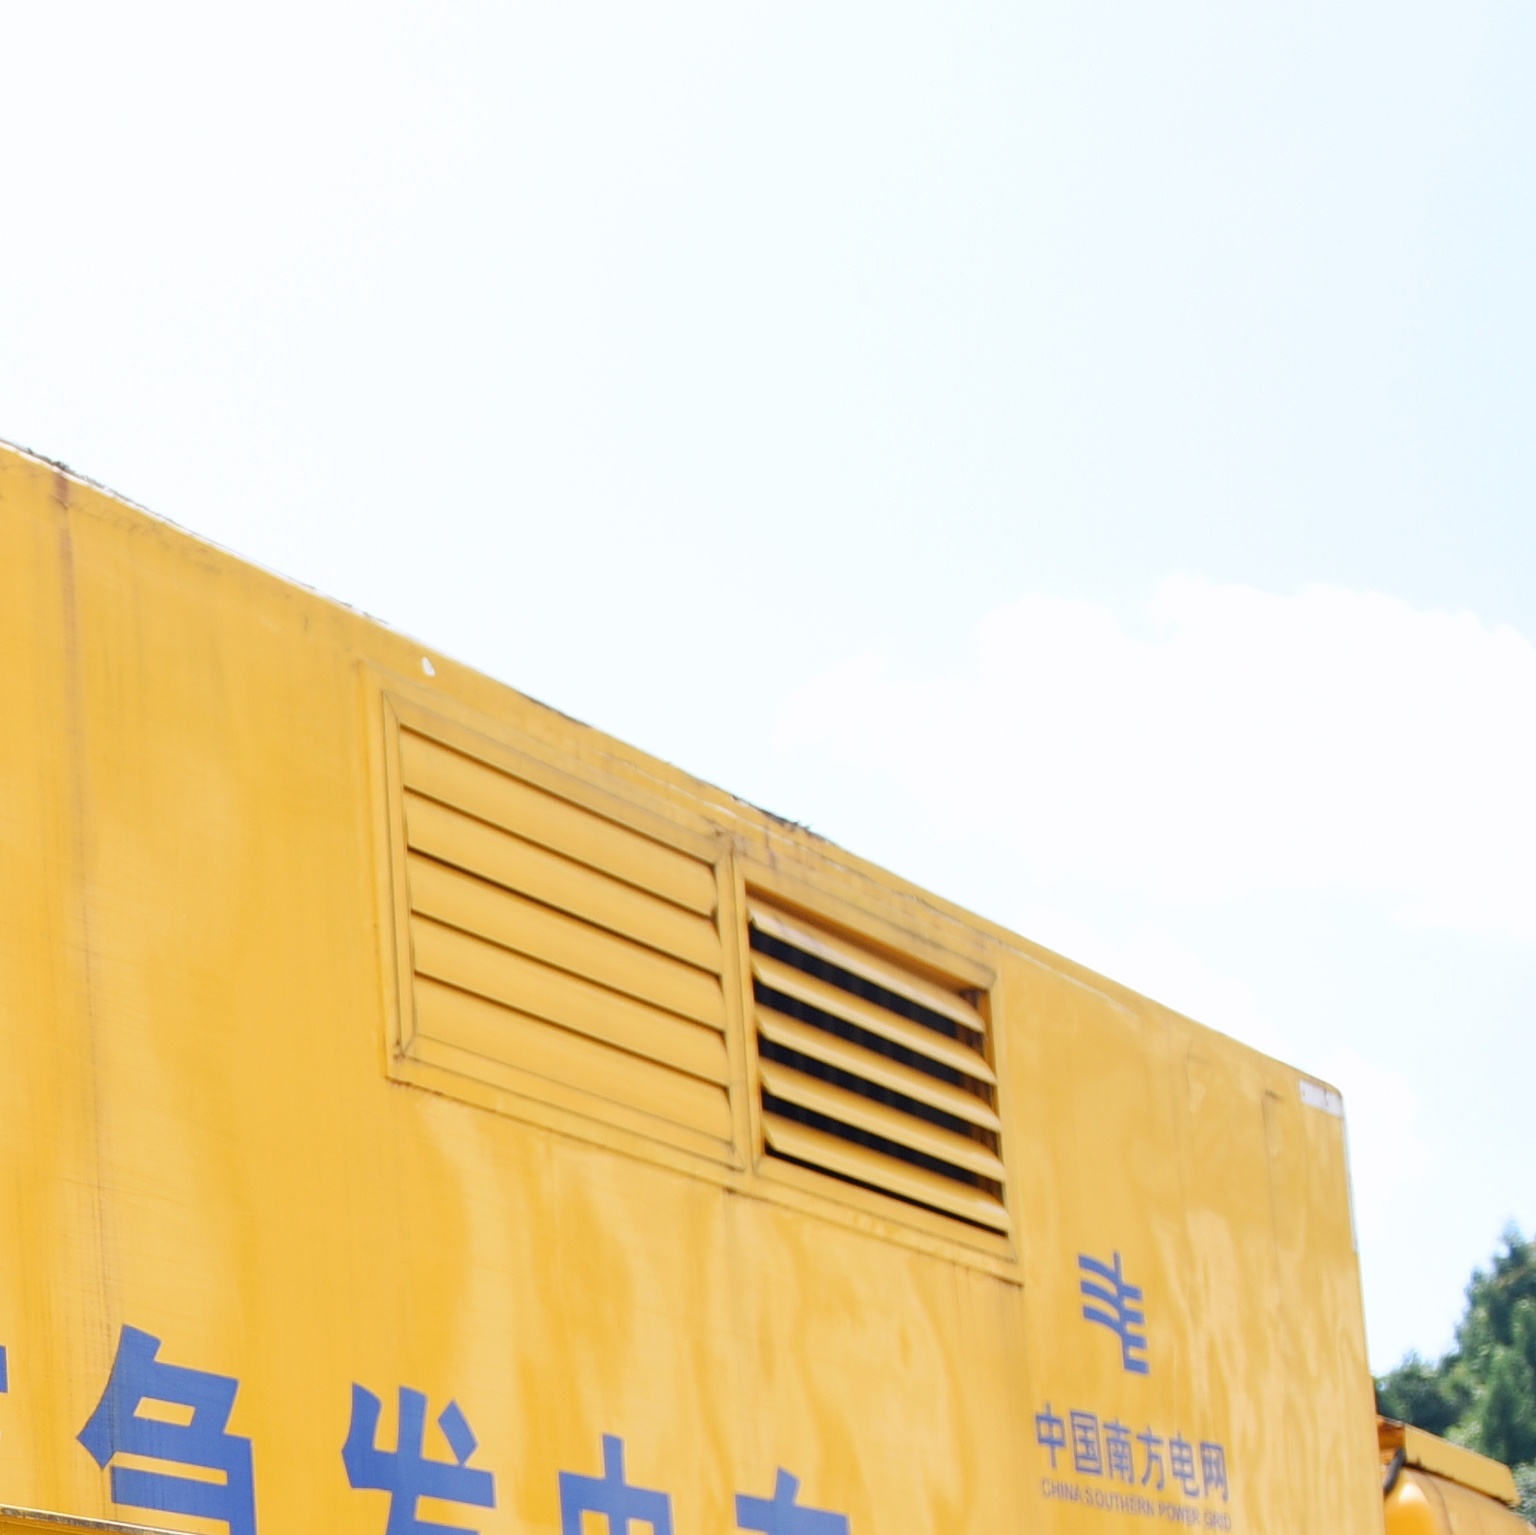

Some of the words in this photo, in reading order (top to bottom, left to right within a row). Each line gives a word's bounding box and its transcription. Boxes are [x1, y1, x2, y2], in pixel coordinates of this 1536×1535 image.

[1034, 1402, 1229, 1504] 中国南方电网
[1041, 1478, 1082, 1502] CHINA
[1085, 1487, 1155, 1518] SOUTHERN
[1158, 1502, 1200, 1525] POWER
